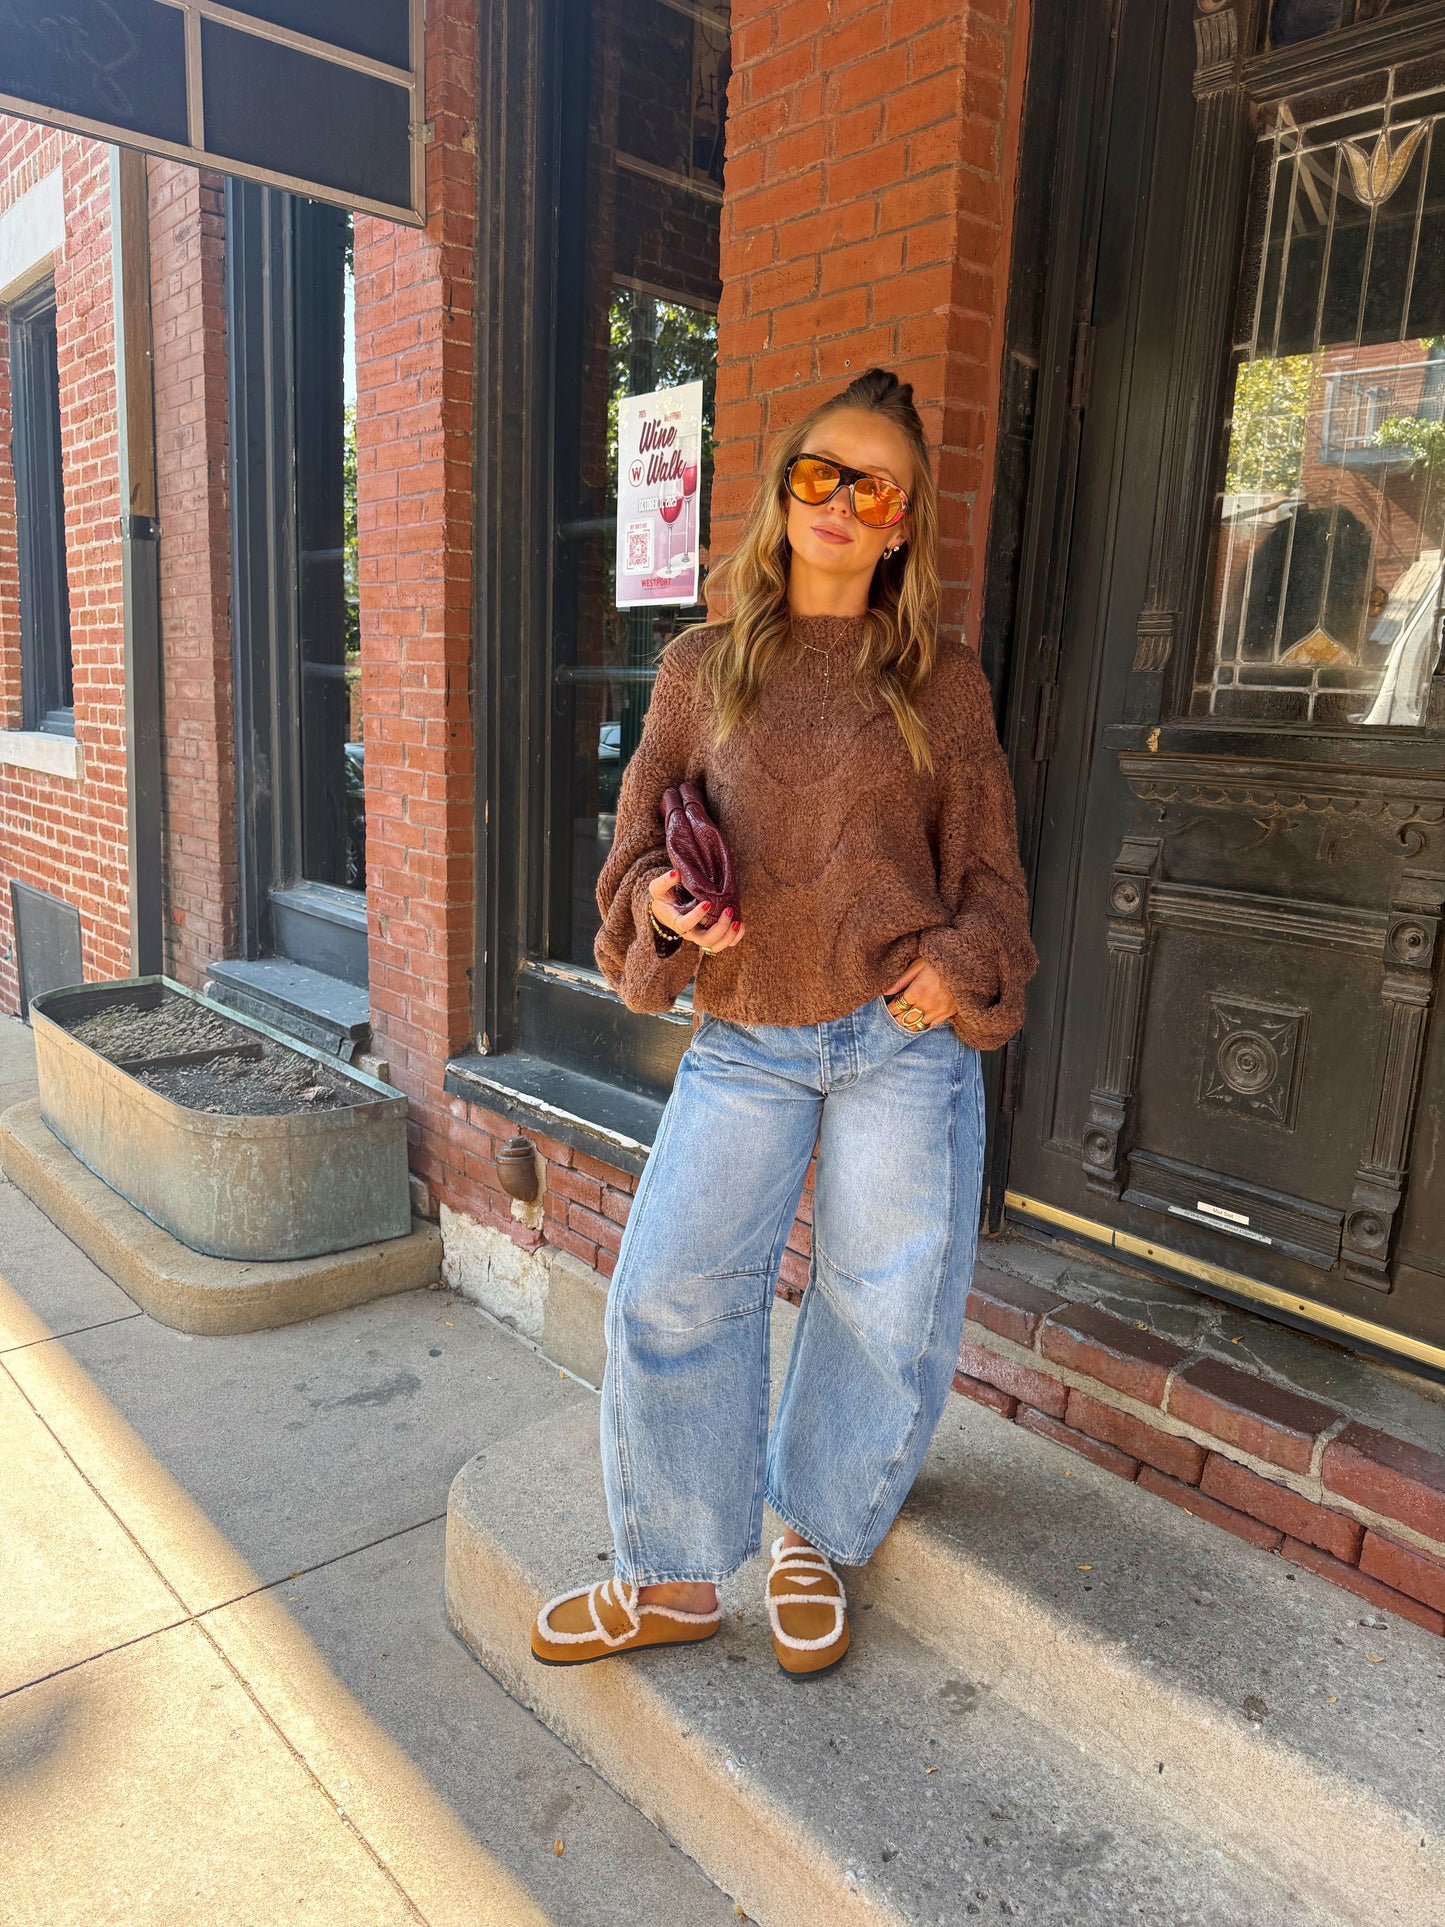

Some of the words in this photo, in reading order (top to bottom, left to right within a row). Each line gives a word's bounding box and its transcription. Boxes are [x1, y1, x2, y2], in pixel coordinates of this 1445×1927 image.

[639, 418, 677, 454] Wine
[632, 466, 641, 481] W
[646, 449, 686, 486] Walk
[641, 577, 671, 587] WESTPORT
